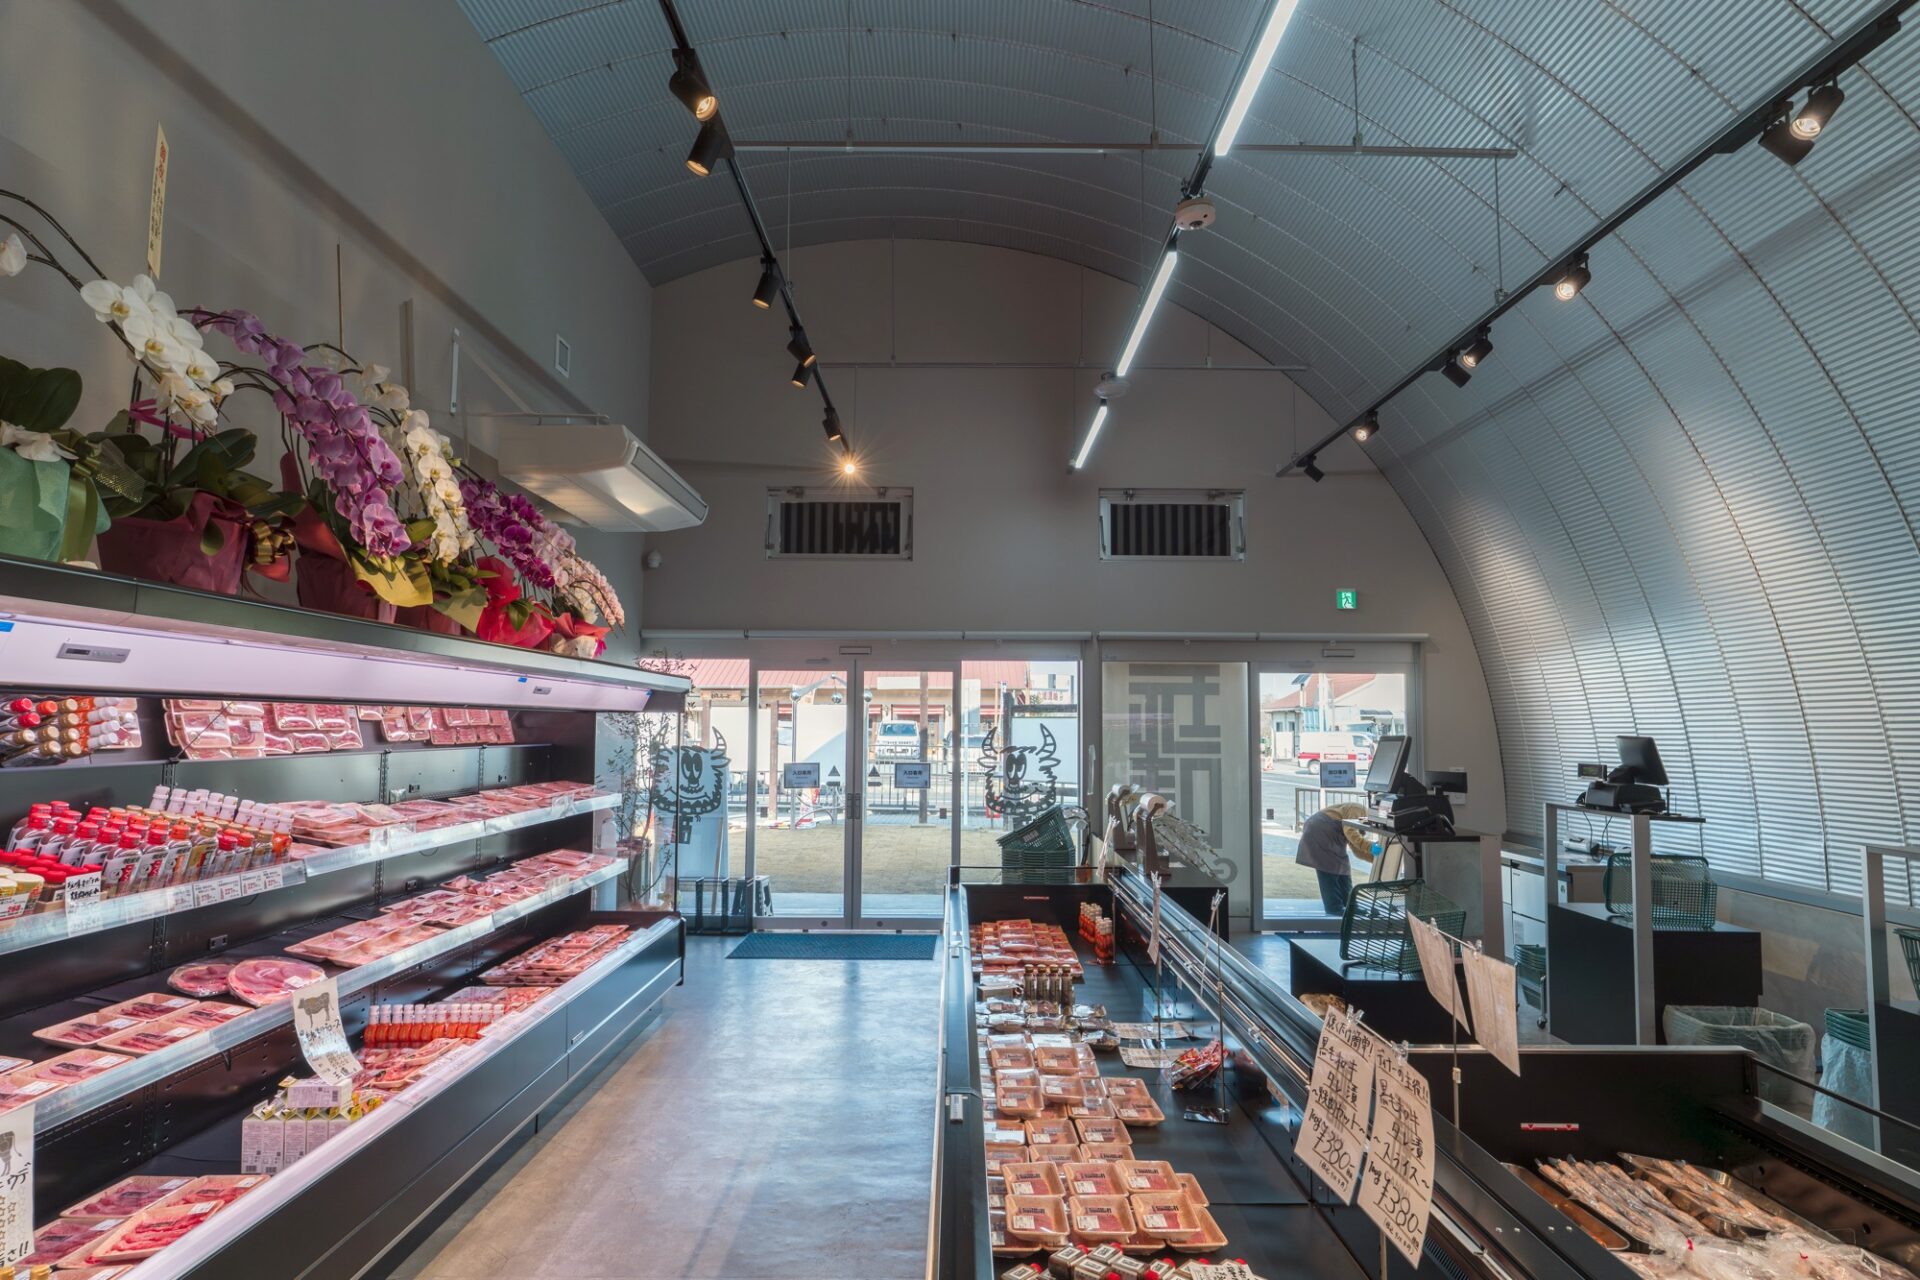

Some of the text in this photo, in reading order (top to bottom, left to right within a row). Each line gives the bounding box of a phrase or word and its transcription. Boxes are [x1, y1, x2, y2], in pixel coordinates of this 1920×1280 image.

[1319, 1036, 1358, 1083] 黒毛和牛
[1380, 1078, 1420, 1135] 黒毛和牛
